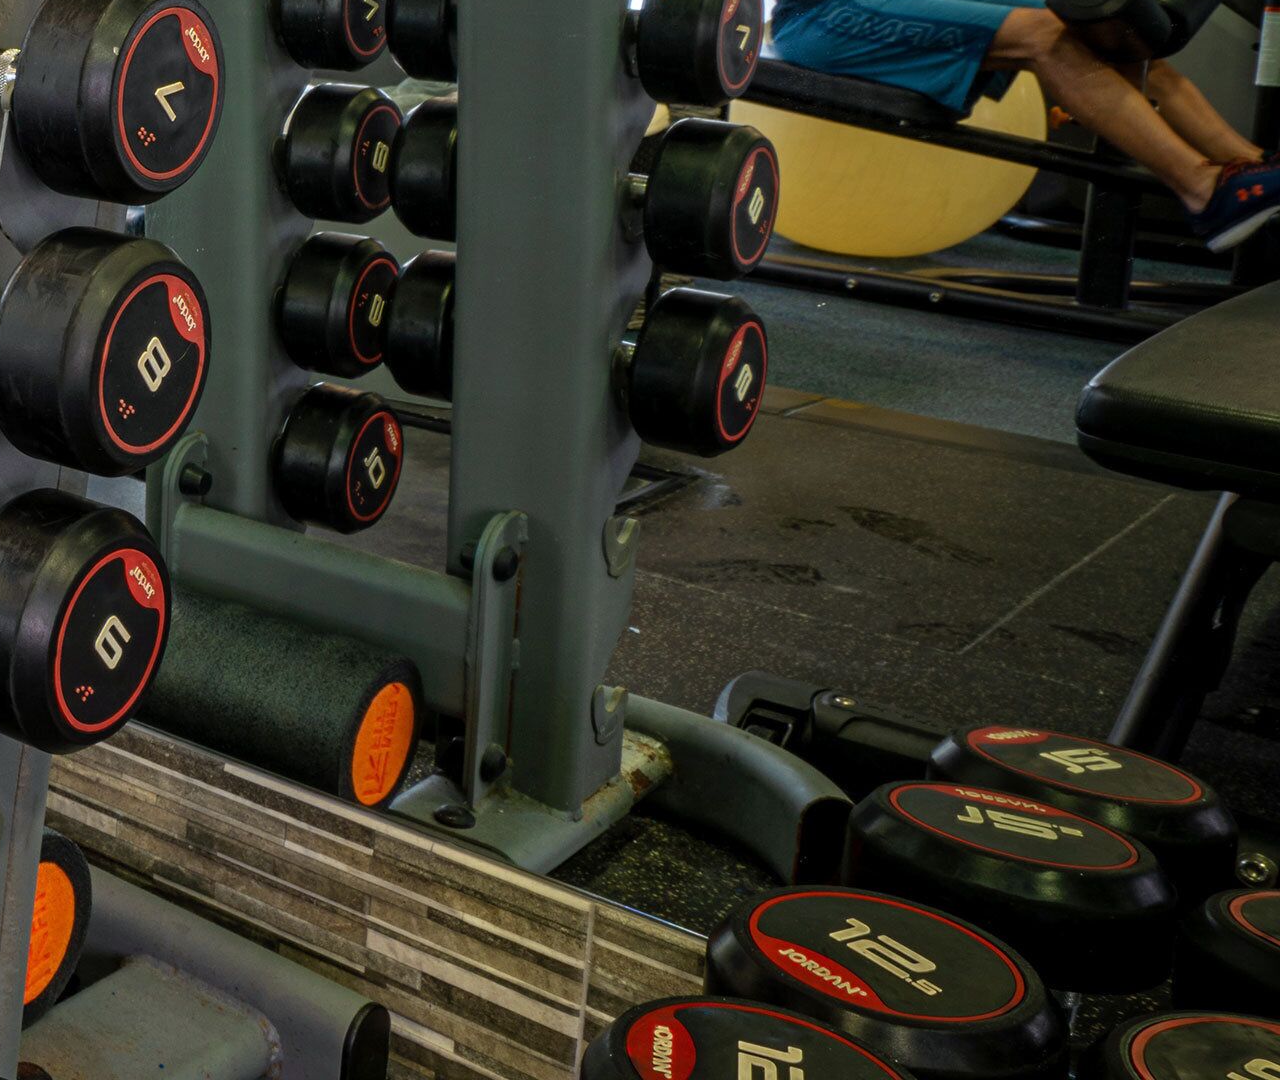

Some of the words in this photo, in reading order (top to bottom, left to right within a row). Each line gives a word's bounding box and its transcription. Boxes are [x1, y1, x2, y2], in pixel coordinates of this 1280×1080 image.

[155, 81, 185, 122] 7
[138, 336, 171, 392] 8
[95, 615, 131, 670] 9
[778, 948, 864, 996] JORDAN
[829, 918, 942, 996] 12.5
[652, 1025, 674, 1073] JORDAN
